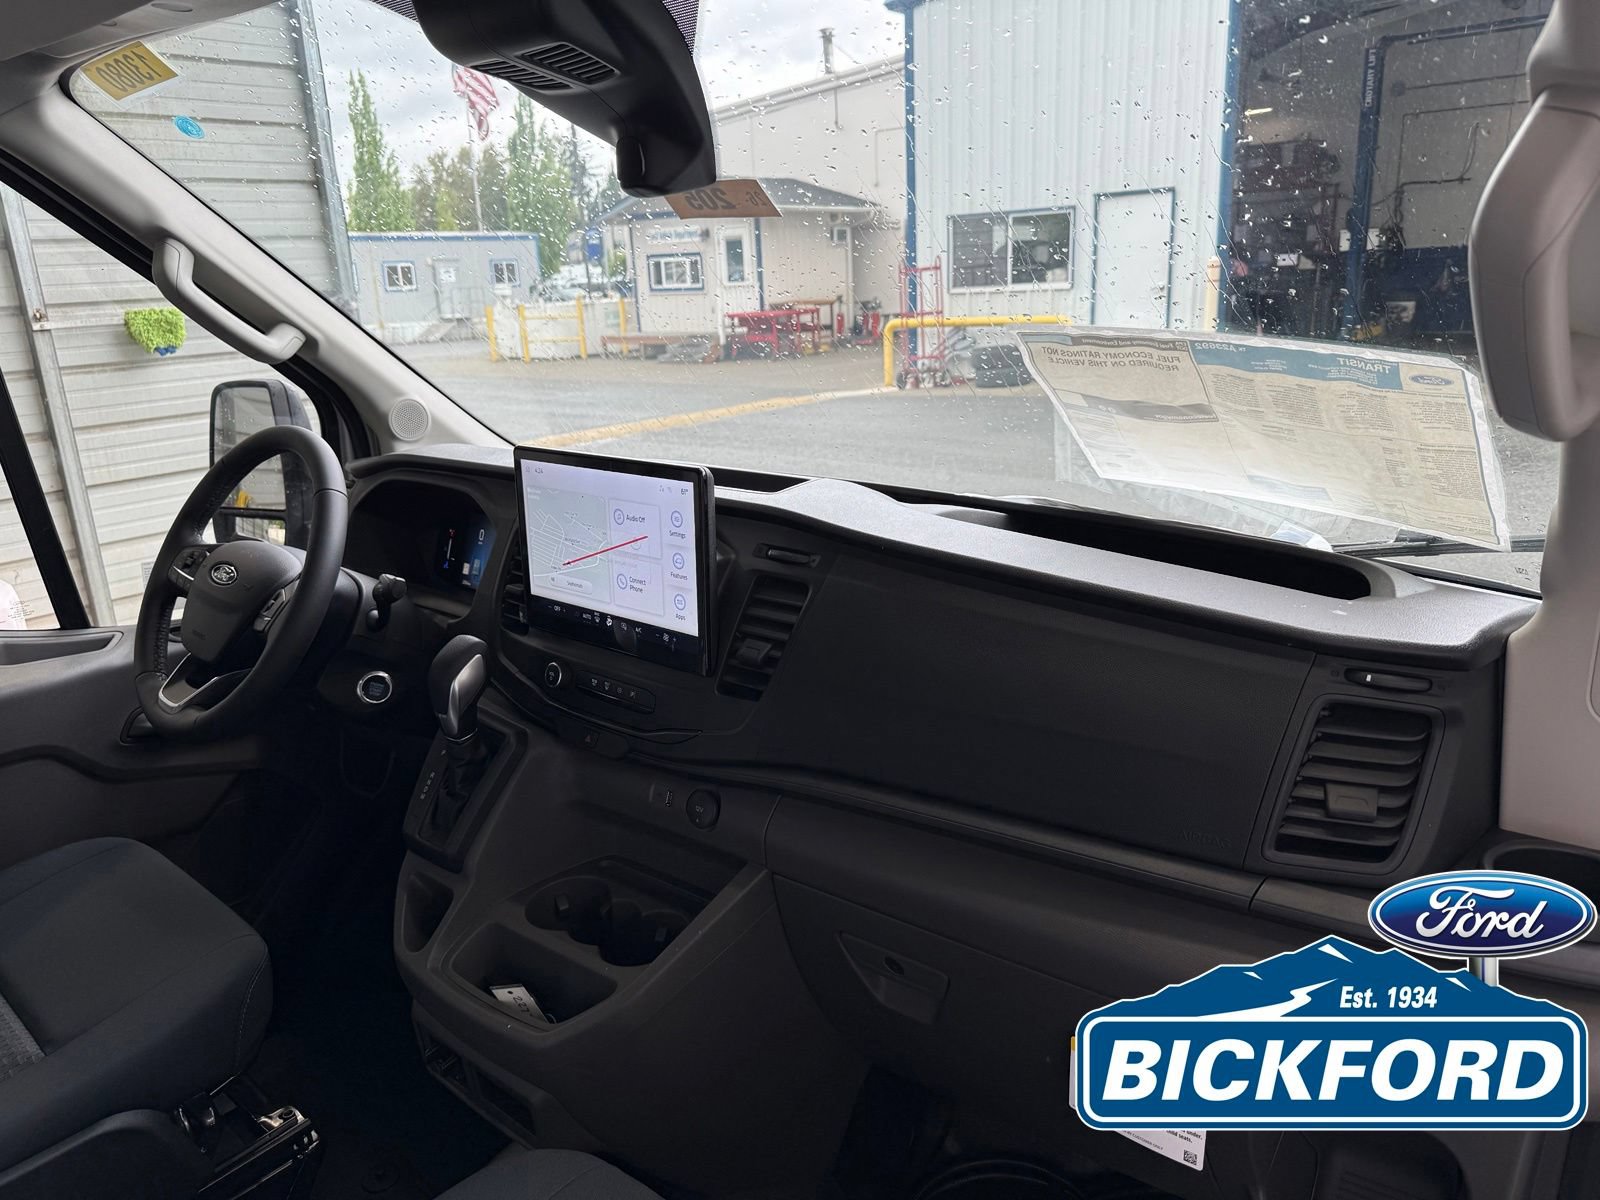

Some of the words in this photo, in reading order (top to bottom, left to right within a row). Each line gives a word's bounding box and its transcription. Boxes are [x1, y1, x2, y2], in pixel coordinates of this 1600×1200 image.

[626, 514, 639, 523] Audio
[638, 516, 646, 524] Off
[669, 530, 686, 539] Settings
[670, 571, 688, 581] Features
[629, 576, 646, 586] Connect
[629, 585, 643, 594] Phone
[675, 613, 686, 621] Apps
